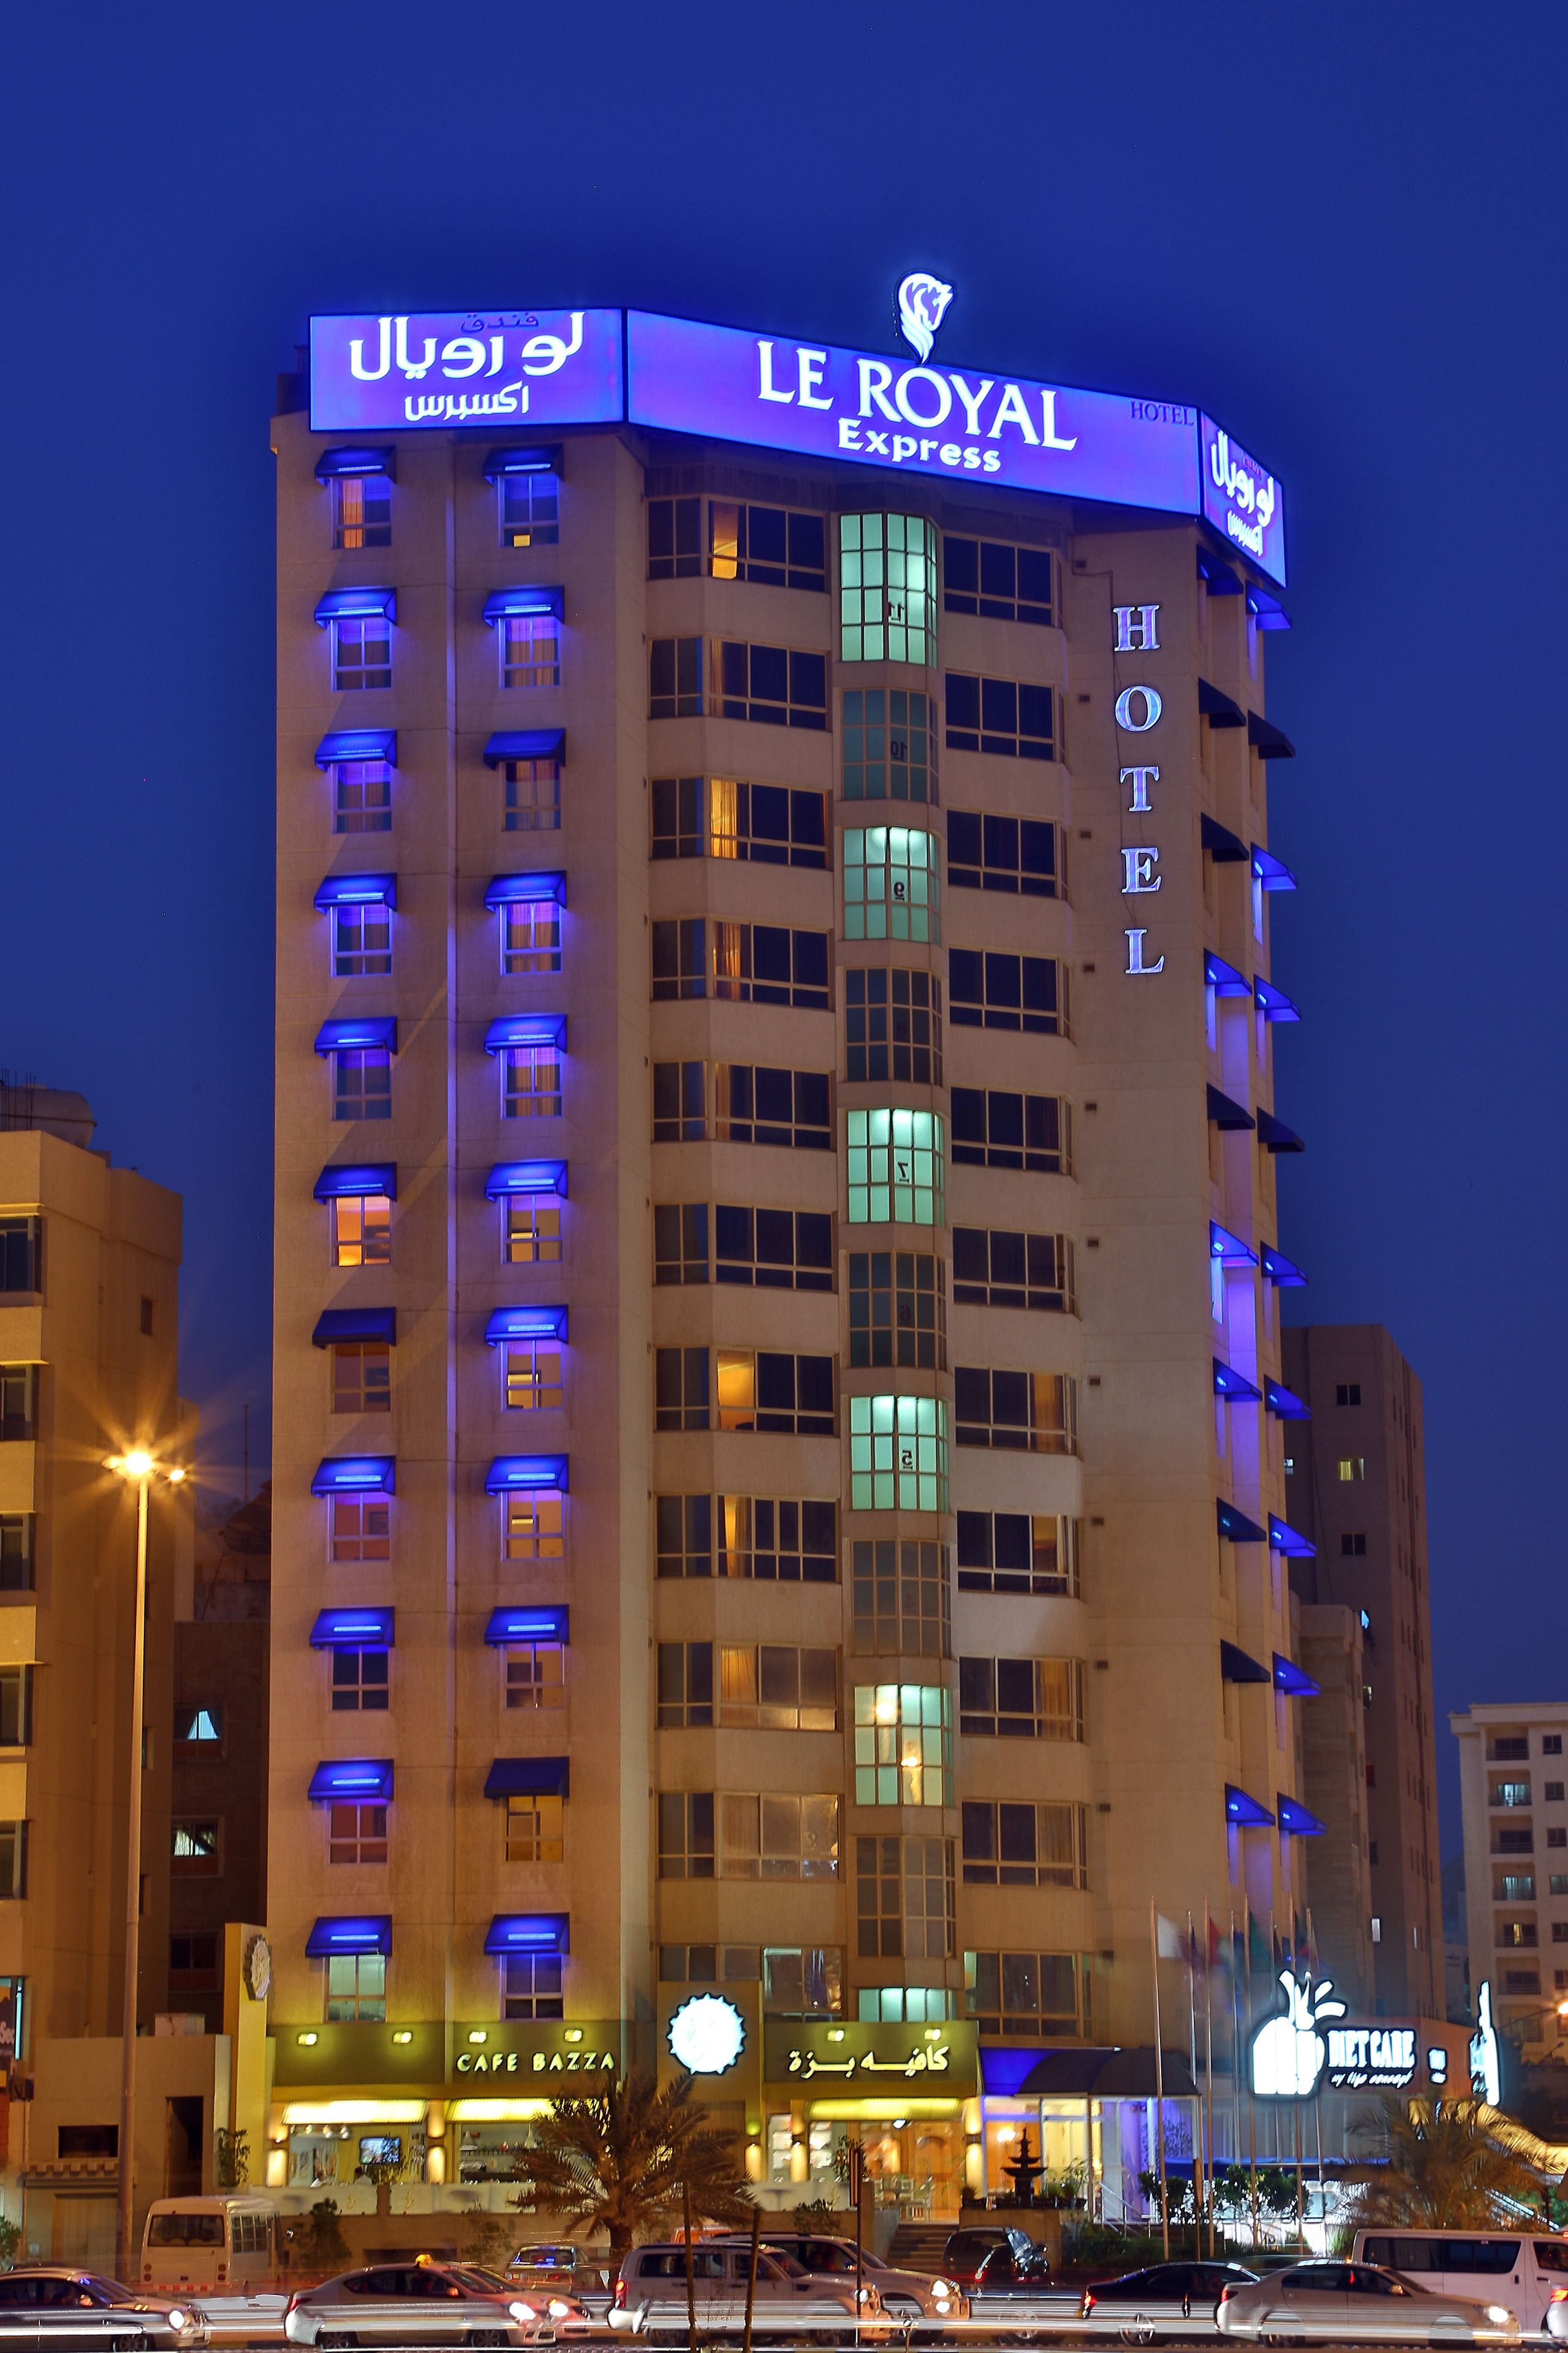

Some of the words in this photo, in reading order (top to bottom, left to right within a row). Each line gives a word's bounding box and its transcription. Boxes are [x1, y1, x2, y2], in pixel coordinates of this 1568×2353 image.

[461, 312, 539, 333] فندق
[521, 311, 585, 377] لو
[349, 316, 504, 381] رويال
[757, 340, 834, 411] LE
[857, 358, 1078, 452] ROYAL
[1131, 401, 1194, 426] HOTEL
[838, 417, 1002, 472] Express
[1112, 604, 1165, 975] HOTEL
[457, 2053, 518, 2072] CAFE
[532, 2052, 615, 2072] BAZZA
[860, 2044, 950, 2077] كافيه
[1327, 2029, 1370, 2067] DIET
[1369, 2029, 1415, 2068] CARE
